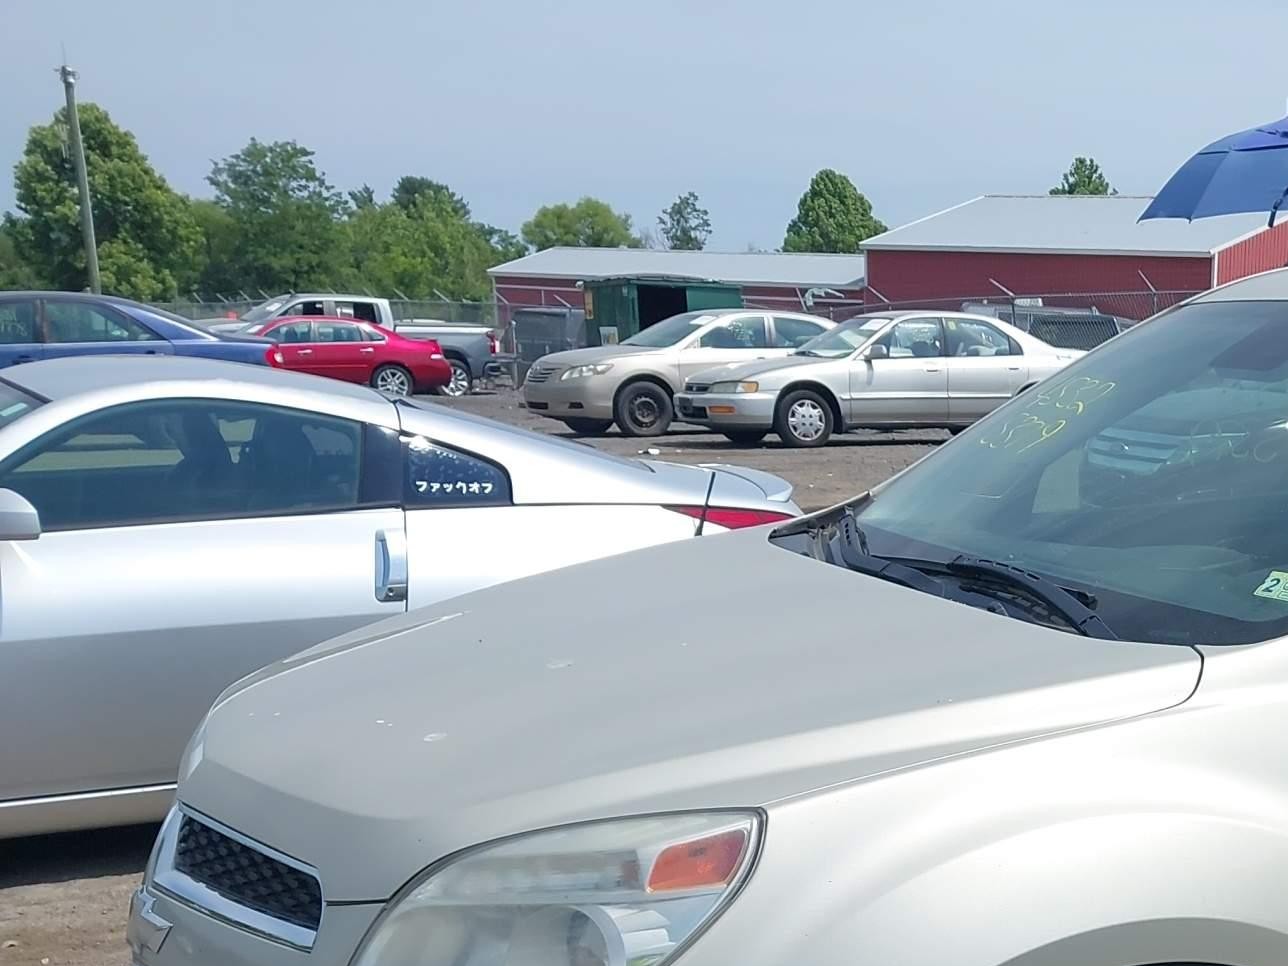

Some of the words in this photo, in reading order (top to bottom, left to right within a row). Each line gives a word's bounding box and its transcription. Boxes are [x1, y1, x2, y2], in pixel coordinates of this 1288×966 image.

[416, 481, 493, 495] ファックオフ
[1262, 578, 1281, 593] 2
